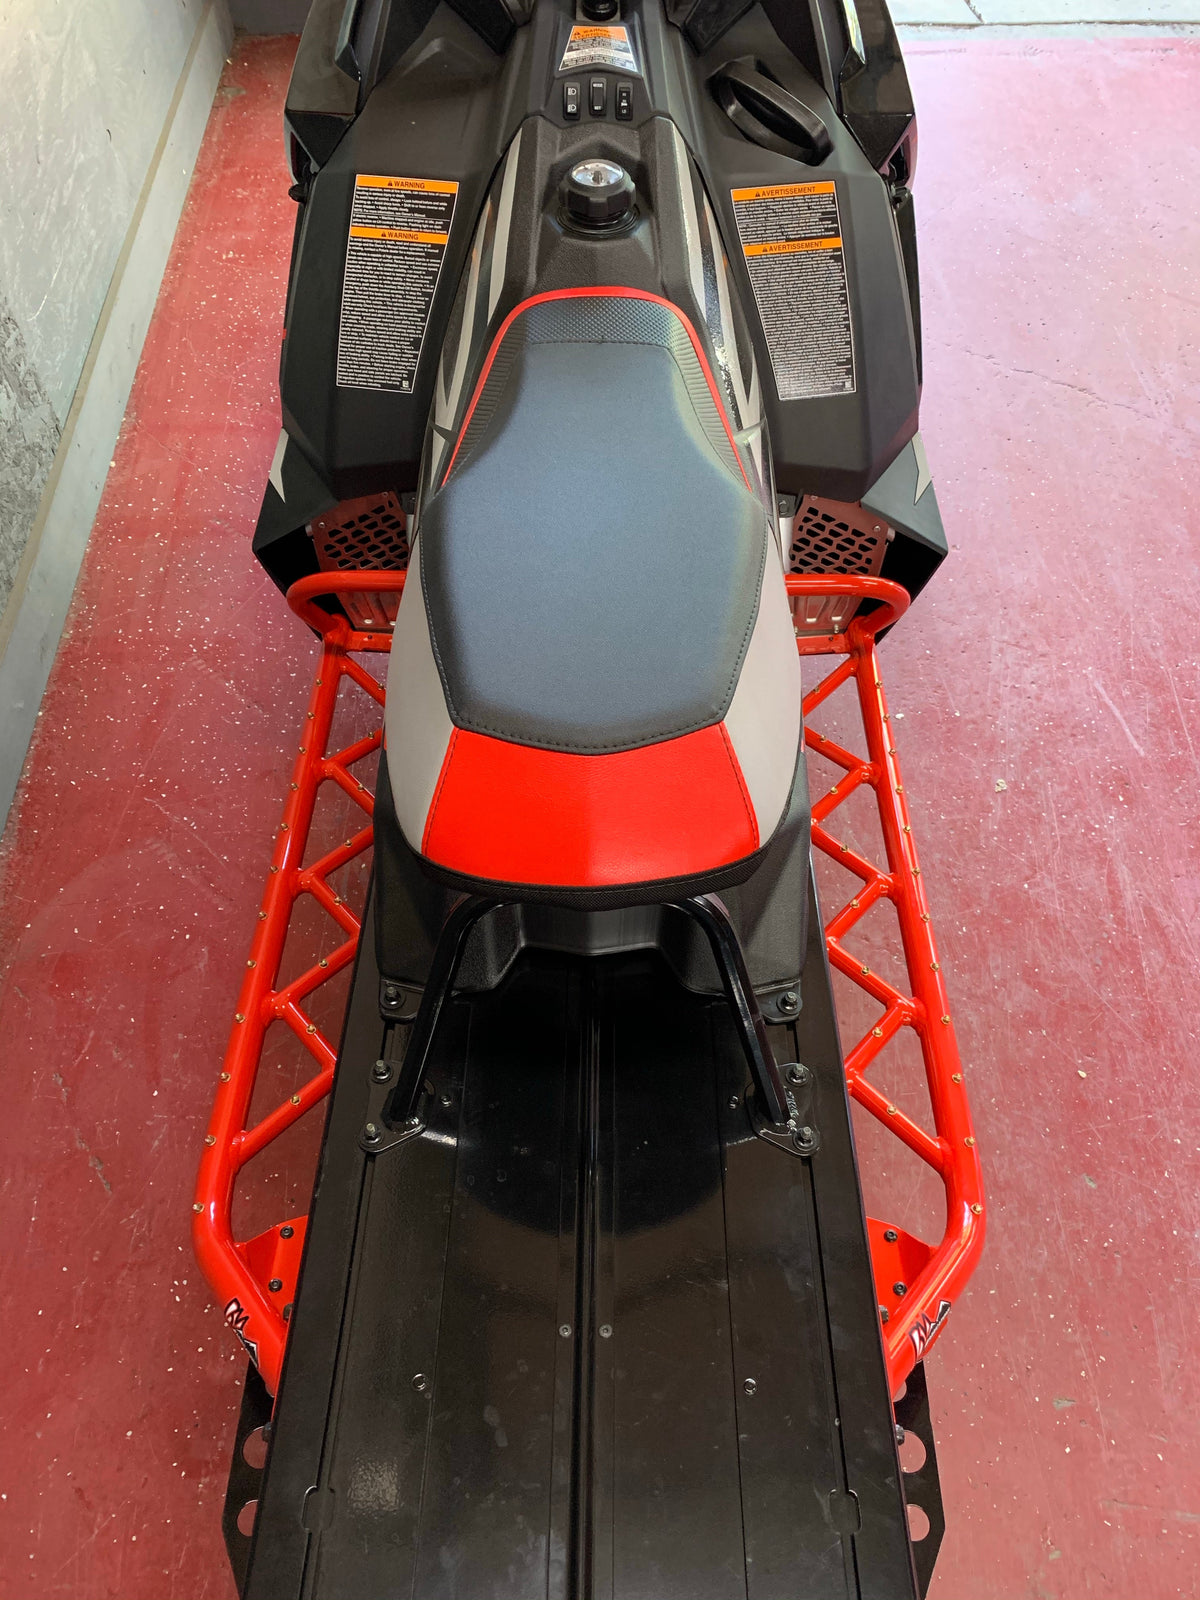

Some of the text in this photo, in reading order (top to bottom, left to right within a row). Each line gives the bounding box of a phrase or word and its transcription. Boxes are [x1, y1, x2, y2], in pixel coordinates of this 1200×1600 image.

[394, 180, 425, 189] WARNING
[761, 186, 816, 197] AVERTISSEMENT
[388, 231, 418, 240] WARNING
[769, 241, 823, 252] AVERTISSEMENT
